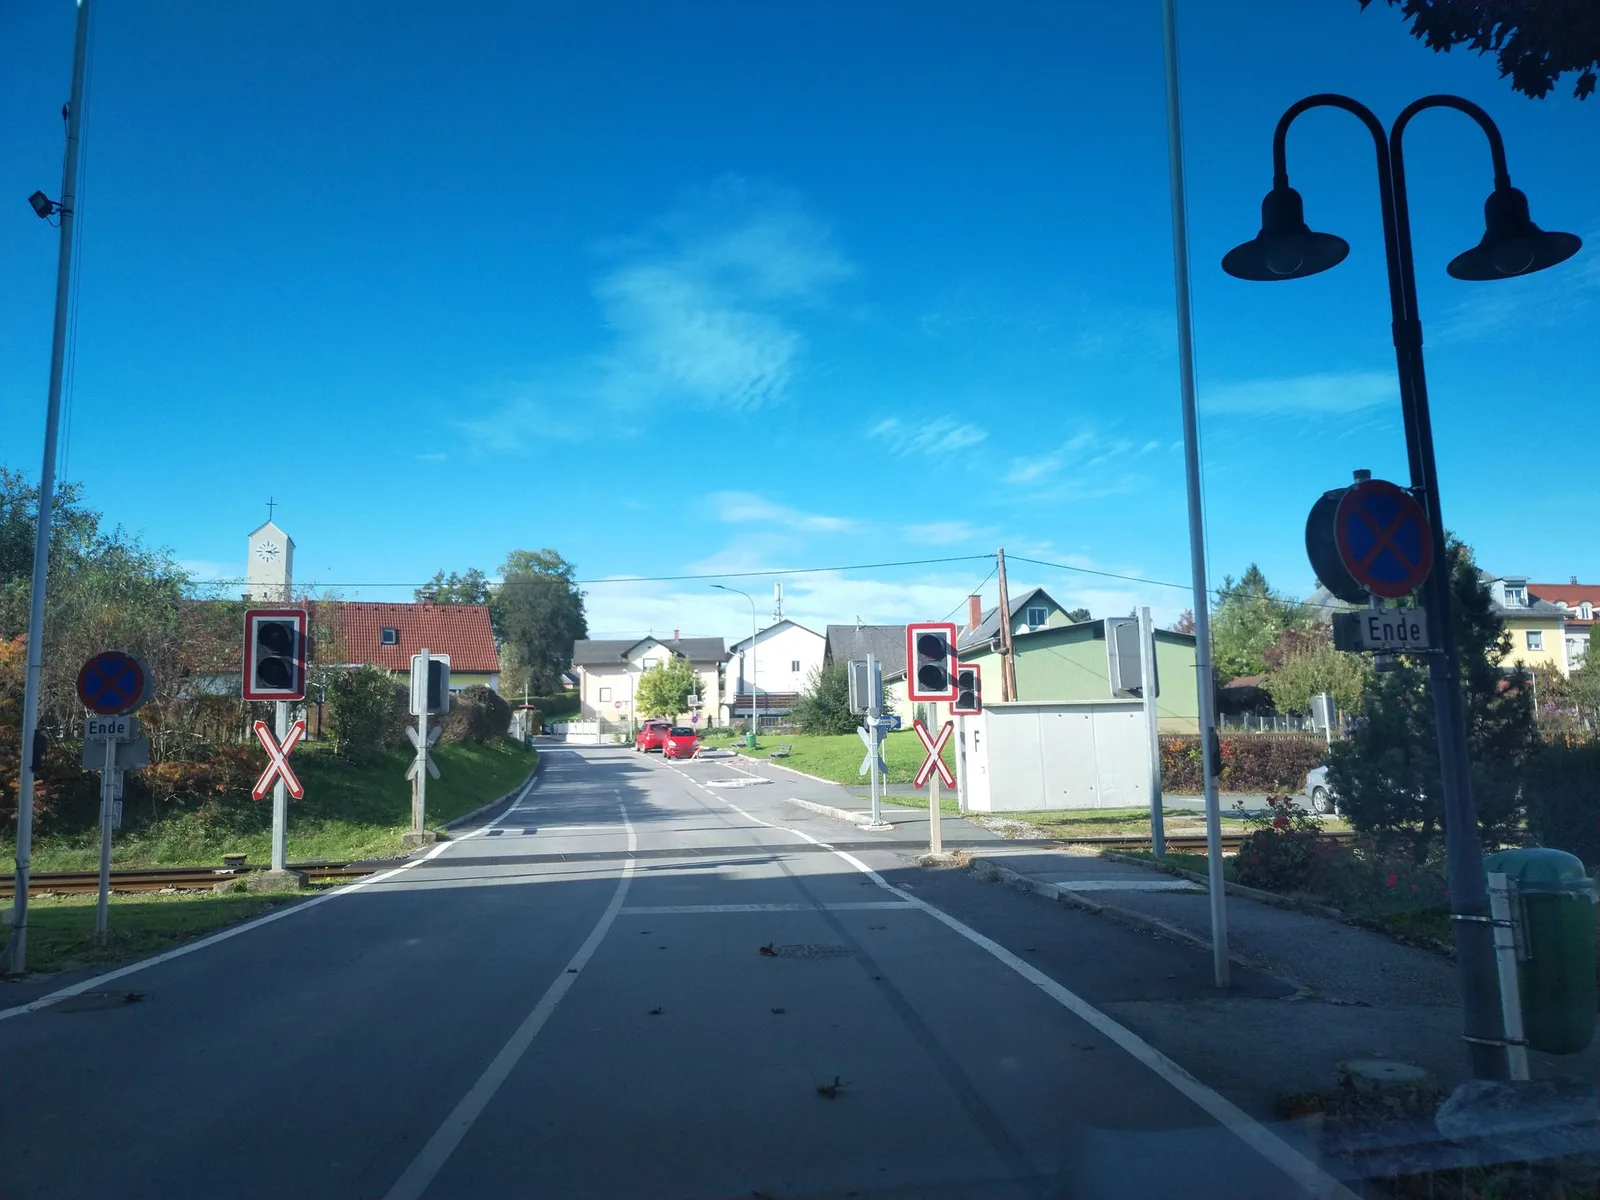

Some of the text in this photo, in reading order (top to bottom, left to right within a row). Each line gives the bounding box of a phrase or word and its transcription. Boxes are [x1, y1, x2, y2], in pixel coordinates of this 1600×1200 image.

[1367, 616, 1421, 641] Ende
[89, 720, 125, 734] Ende
[973, 730, 980, 753] F
